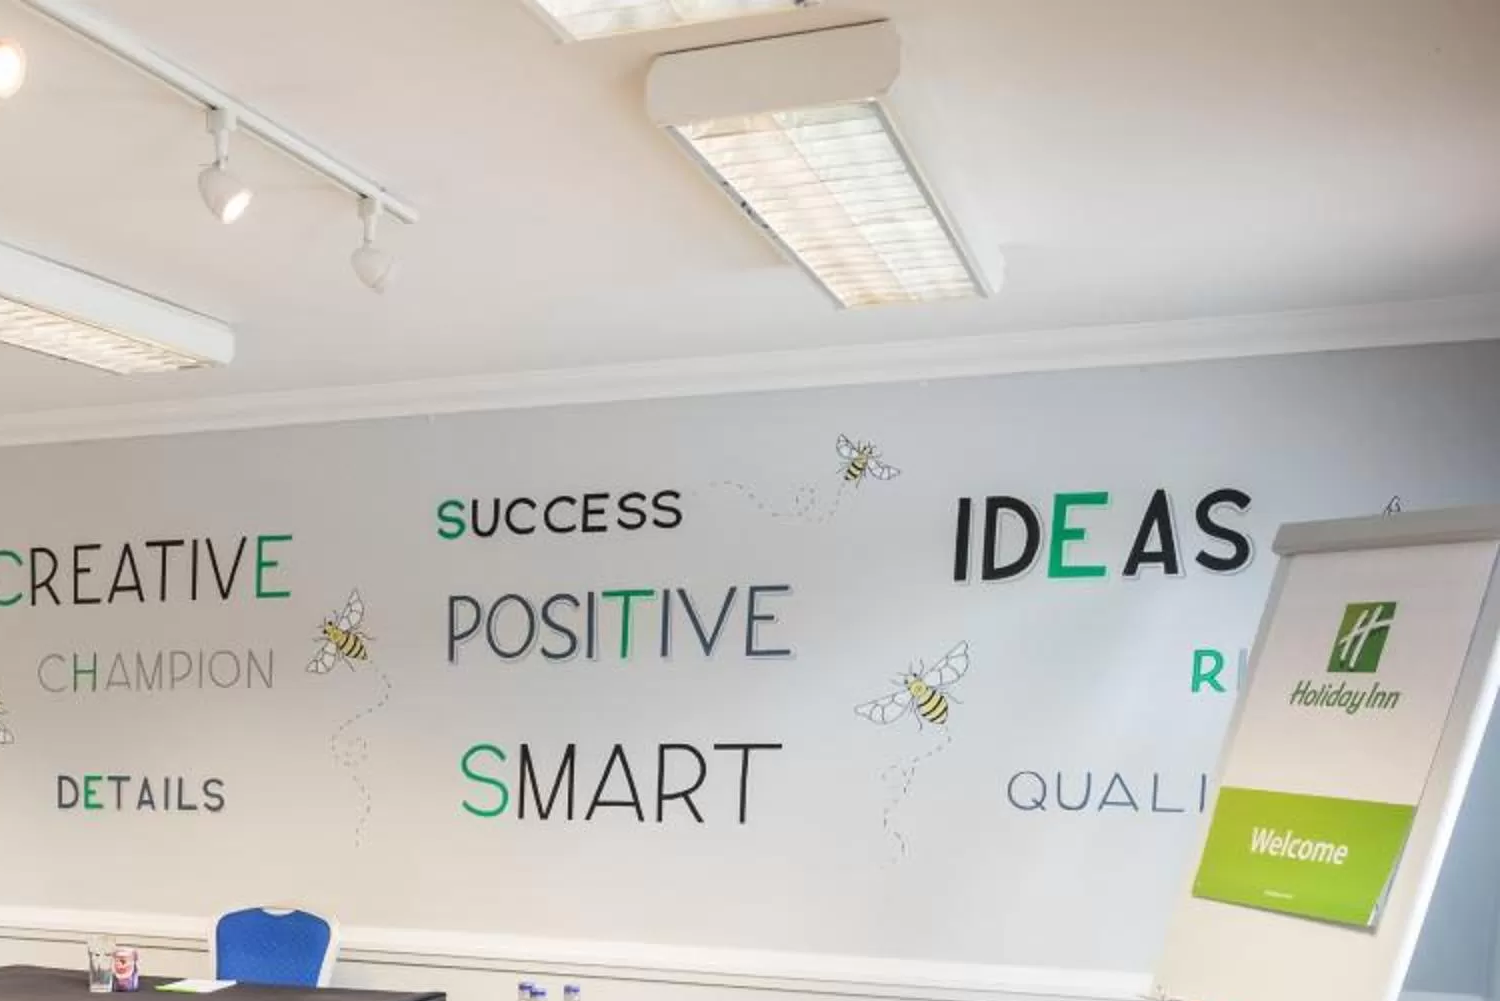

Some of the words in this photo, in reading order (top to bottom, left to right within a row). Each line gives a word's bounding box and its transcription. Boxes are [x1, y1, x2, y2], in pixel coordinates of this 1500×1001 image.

[437, 490, 683, 540] SUCCESS
[953, 488, 1254, 582] IDEAS
[447, 585, 794, 663] POSITIVE
[37, 648, 273, 693] CHAMPION
[1191, 648, 1248, 692] R
[1289, 680, 1367, 714] Holiday
[1364, 681, 1402, 708] Inn
[57, 775, 225, 812] DETAILS
[460, 743, 783, 825] SMART
[1251, 826, 1349, 865] Welcome
